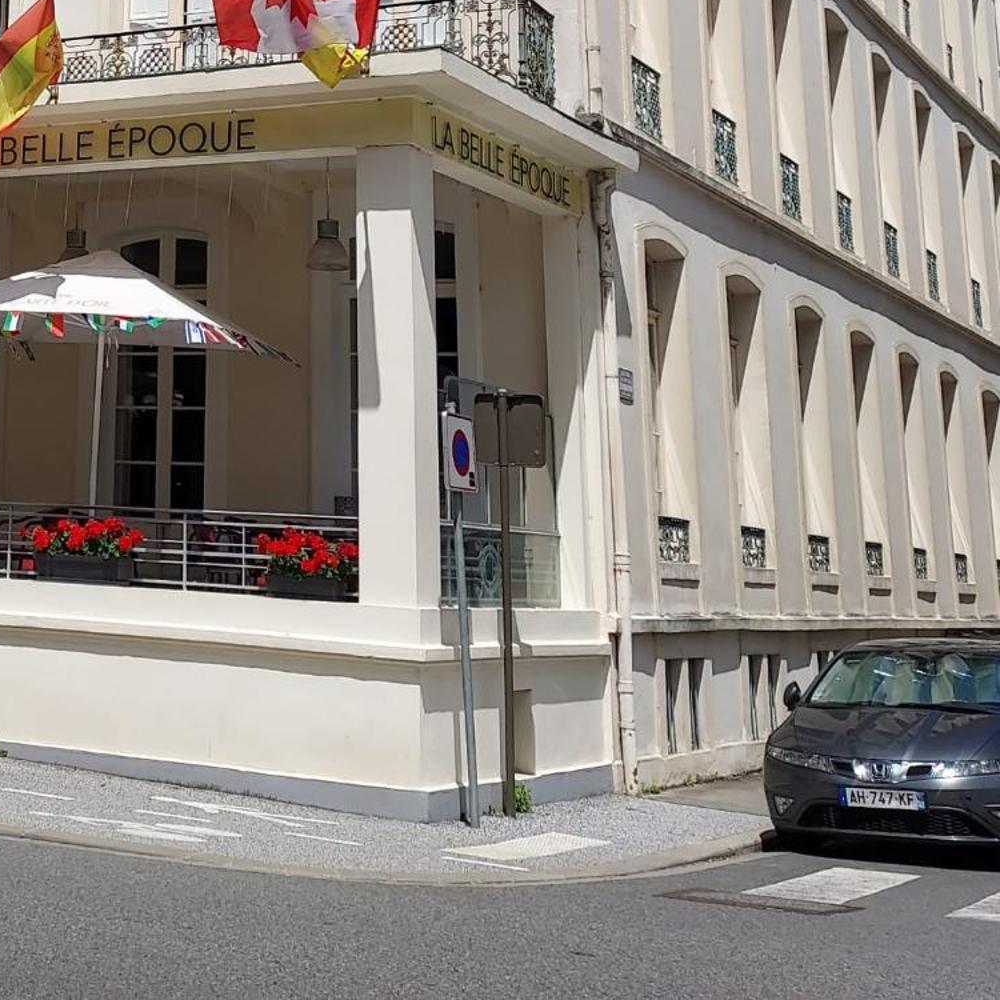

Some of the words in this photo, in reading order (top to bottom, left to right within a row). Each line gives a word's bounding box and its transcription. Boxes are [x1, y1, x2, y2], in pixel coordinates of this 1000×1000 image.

[0, 130, 94, 166] BELLE
[107, 118, 256, 159] ÉPOQUE
[431, 116, 455, 155] LA
[460, 128, 504, 178] BELLE
[511, 146, 571, 207] ÉPOQUE
